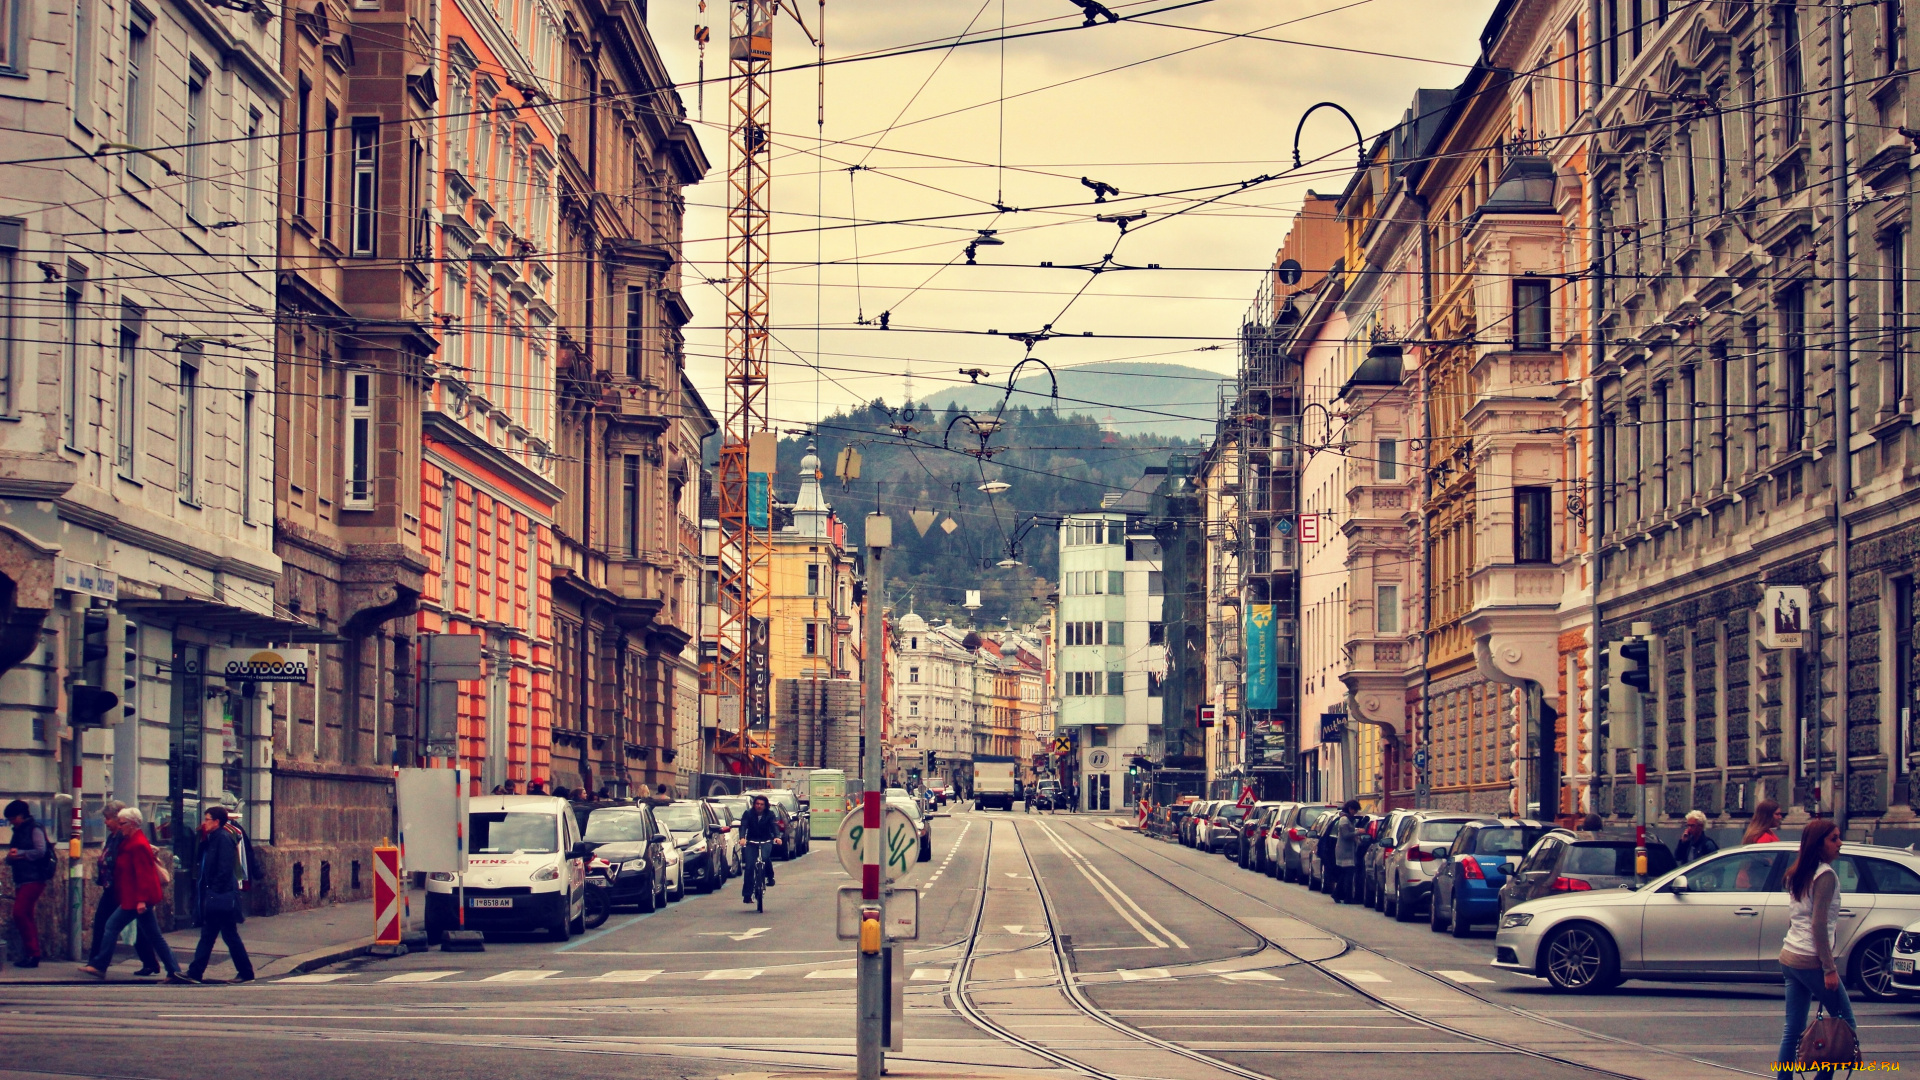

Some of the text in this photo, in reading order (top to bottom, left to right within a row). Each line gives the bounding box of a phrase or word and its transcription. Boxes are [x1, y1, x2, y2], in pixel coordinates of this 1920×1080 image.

[1303, 519, 1315, 538] E
[227, 661, 306, 674] OUTDOOR
[755, 654, 764, 725] umfeld
[1417, 754, 1425, 763] P
[483, 899, 499, 907] 8518
[500, 899, 510, 907] AM
